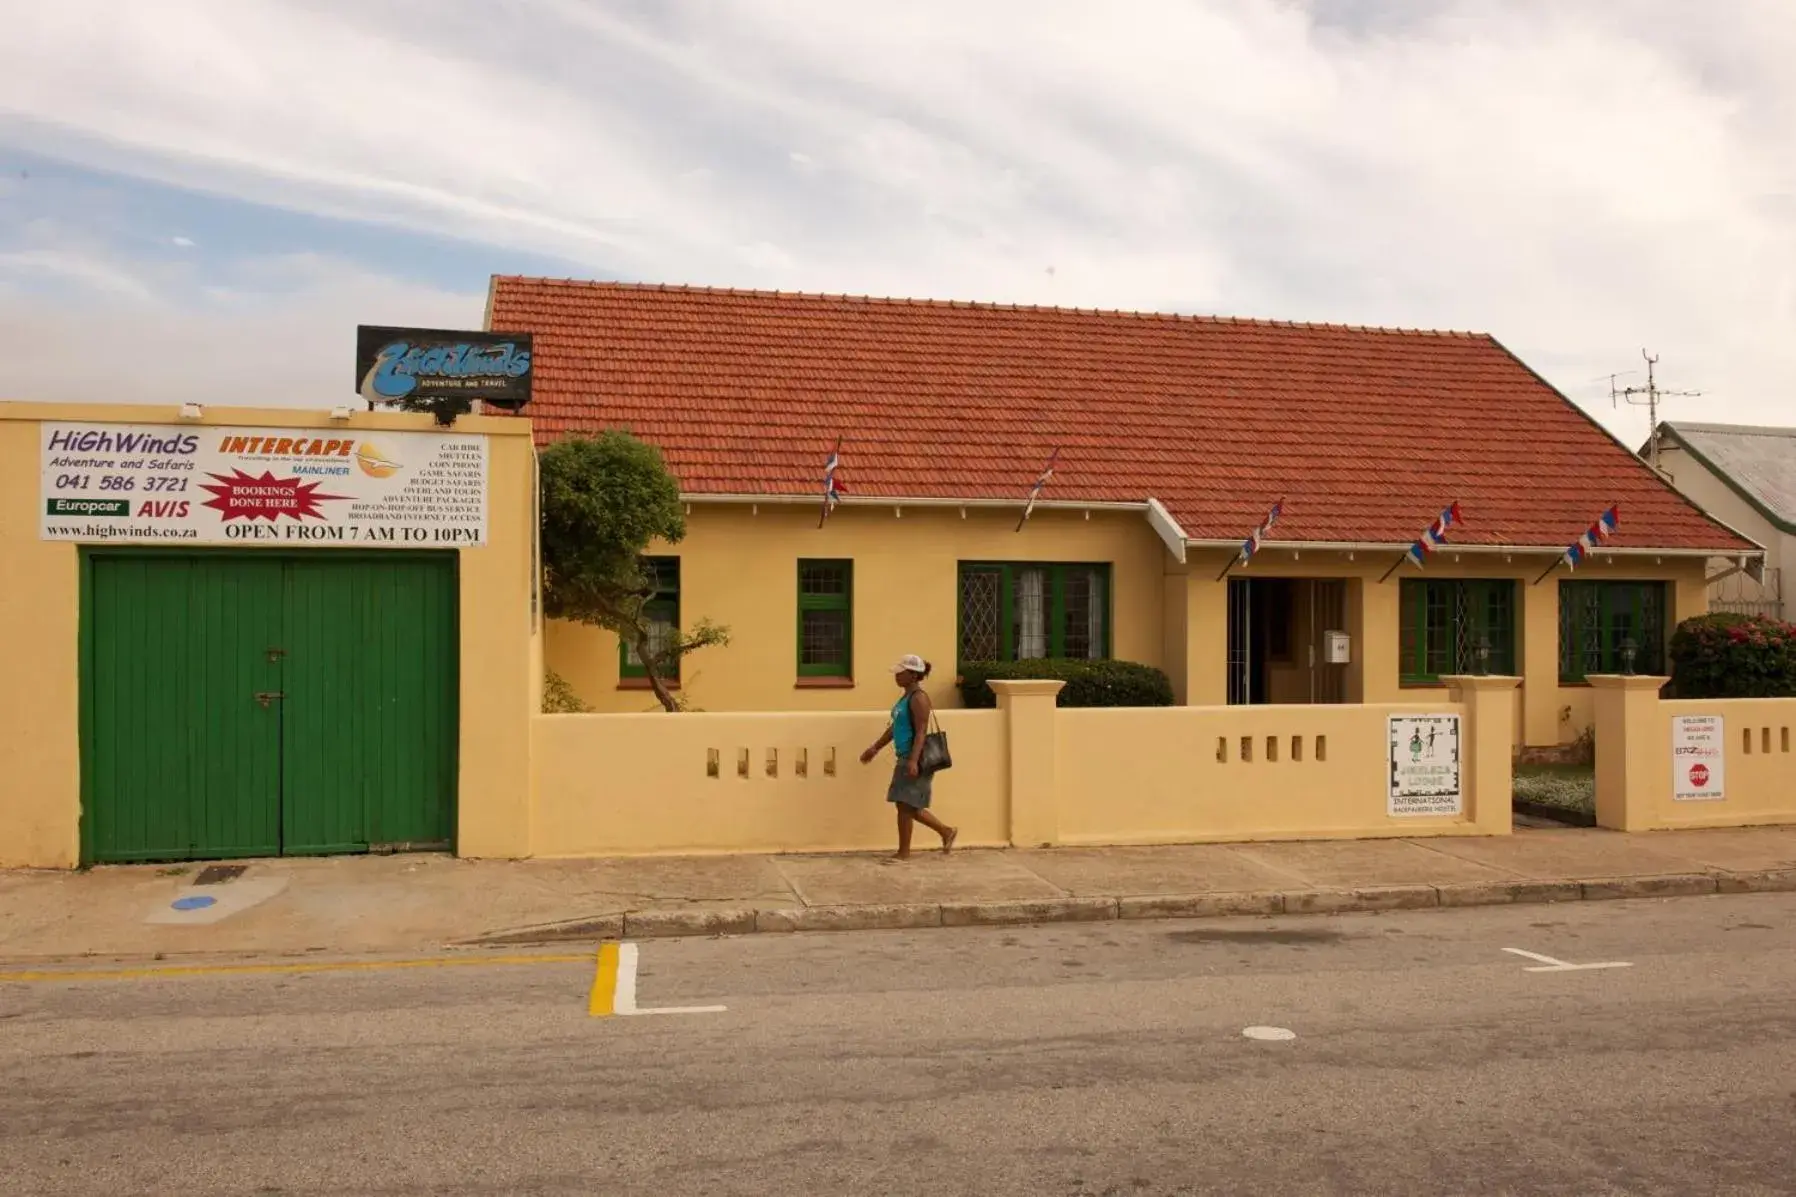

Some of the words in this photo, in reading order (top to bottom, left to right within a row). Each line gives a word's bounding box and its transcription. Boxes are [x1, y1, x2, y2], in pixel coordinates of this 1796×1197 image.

[219, 437, 355, 456] INTERCAPE
[50, 457, 113, 468] Adventure
[121, 460, 143, 469] and
[149, 460, 195, 470] Safaris
[293, 466, 349, 475] MAINLINER
[56, 475, 89, 489] 041
[99, 477, 134, 490] 586
[143, 477, 188, 492] 3721
[233, 486, 295, 496] BOOKINGS
[56, 500, 121, 514] Europcar
[137, 501, 190, 517] AVIS
[230, 498, 263, 507] DONE
[266, 499, 297, 508] HERE
[48, 525, 197, 538] www.highwinds.co.za
[225, 525, 279, 539] OPEN
[286, 526, 342, 540] FROM
[350, 527, 358, 540] 7
[364, 527, 395, 540] AM
[402, 527, 427, 541] TO
[435, 528, 479, 541] 10PM
